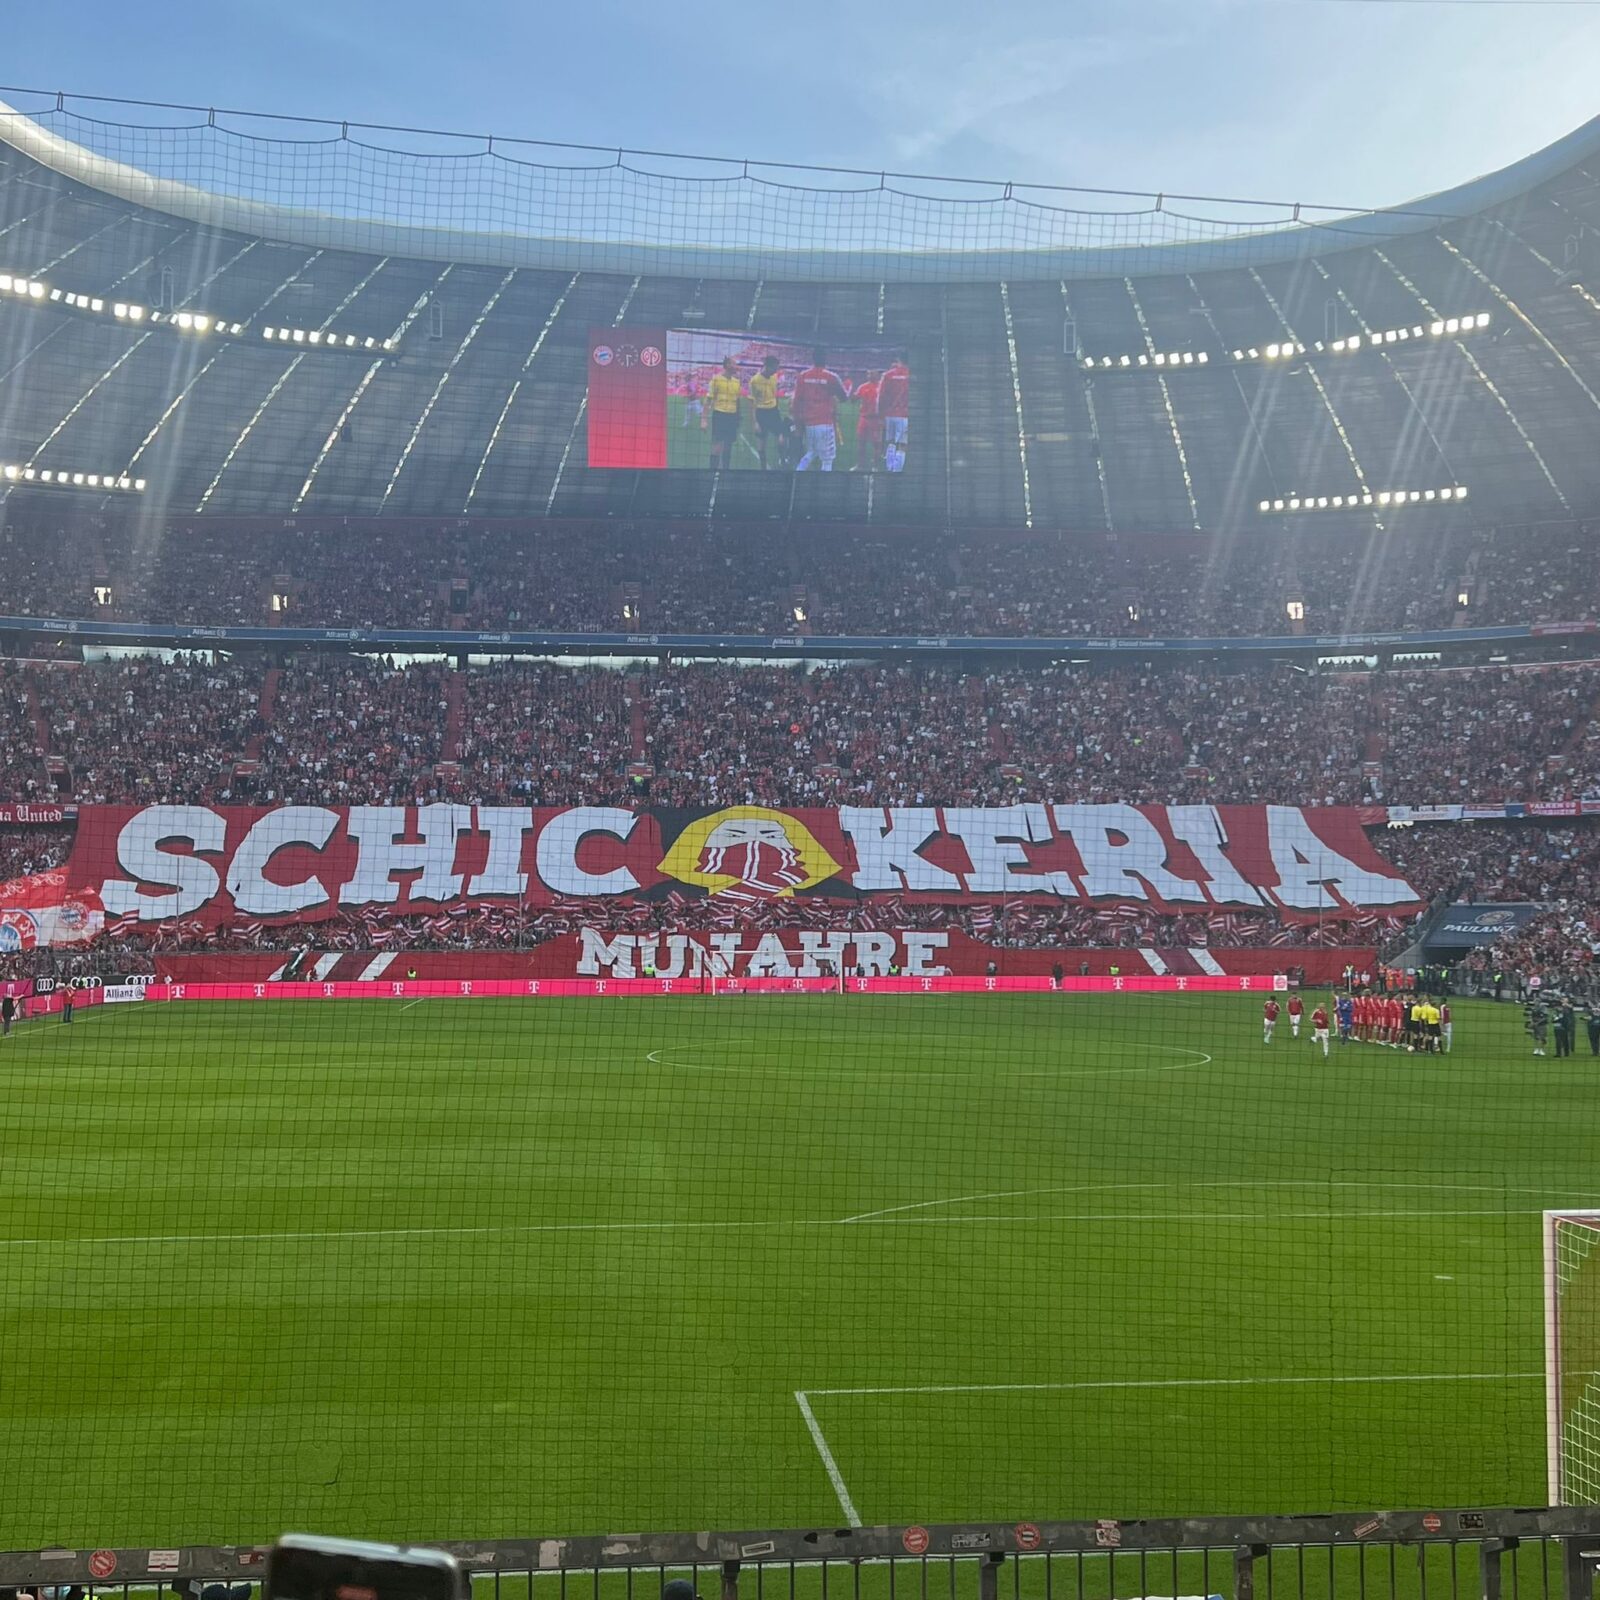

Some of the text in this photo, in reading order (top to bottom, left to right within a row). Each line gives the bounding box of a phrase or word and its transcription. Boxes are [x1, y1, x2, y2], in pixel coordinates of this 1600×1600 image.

[43, 621, 67, 629] Allianz
[192, 628, 217, 636] Allianz
[16, 804, 62, 821] United
[393, 982, 403, 995] T
[461, 982, 471, 994] T
[529, 981, 539, 993] T
[595, 980, 606, 992] T
[662, 980, 672, 992] T
[728, 979, 738, 988] T
[793, 979, 803, 988] T
[857, 978, 867, 990] T
[921, 978, 931, 990] T
[986, 978, 995, 990] T
[1113, 978, 1123, 989] T
[1176, 978, 1186, 989] T
[1240, 977, 1250, 989] T
[105, 989, 133, 999] Allianz
[171, 985, 184, 998] T
[254, 984, 264, 996] T
[324, 983, 334, 996] T
